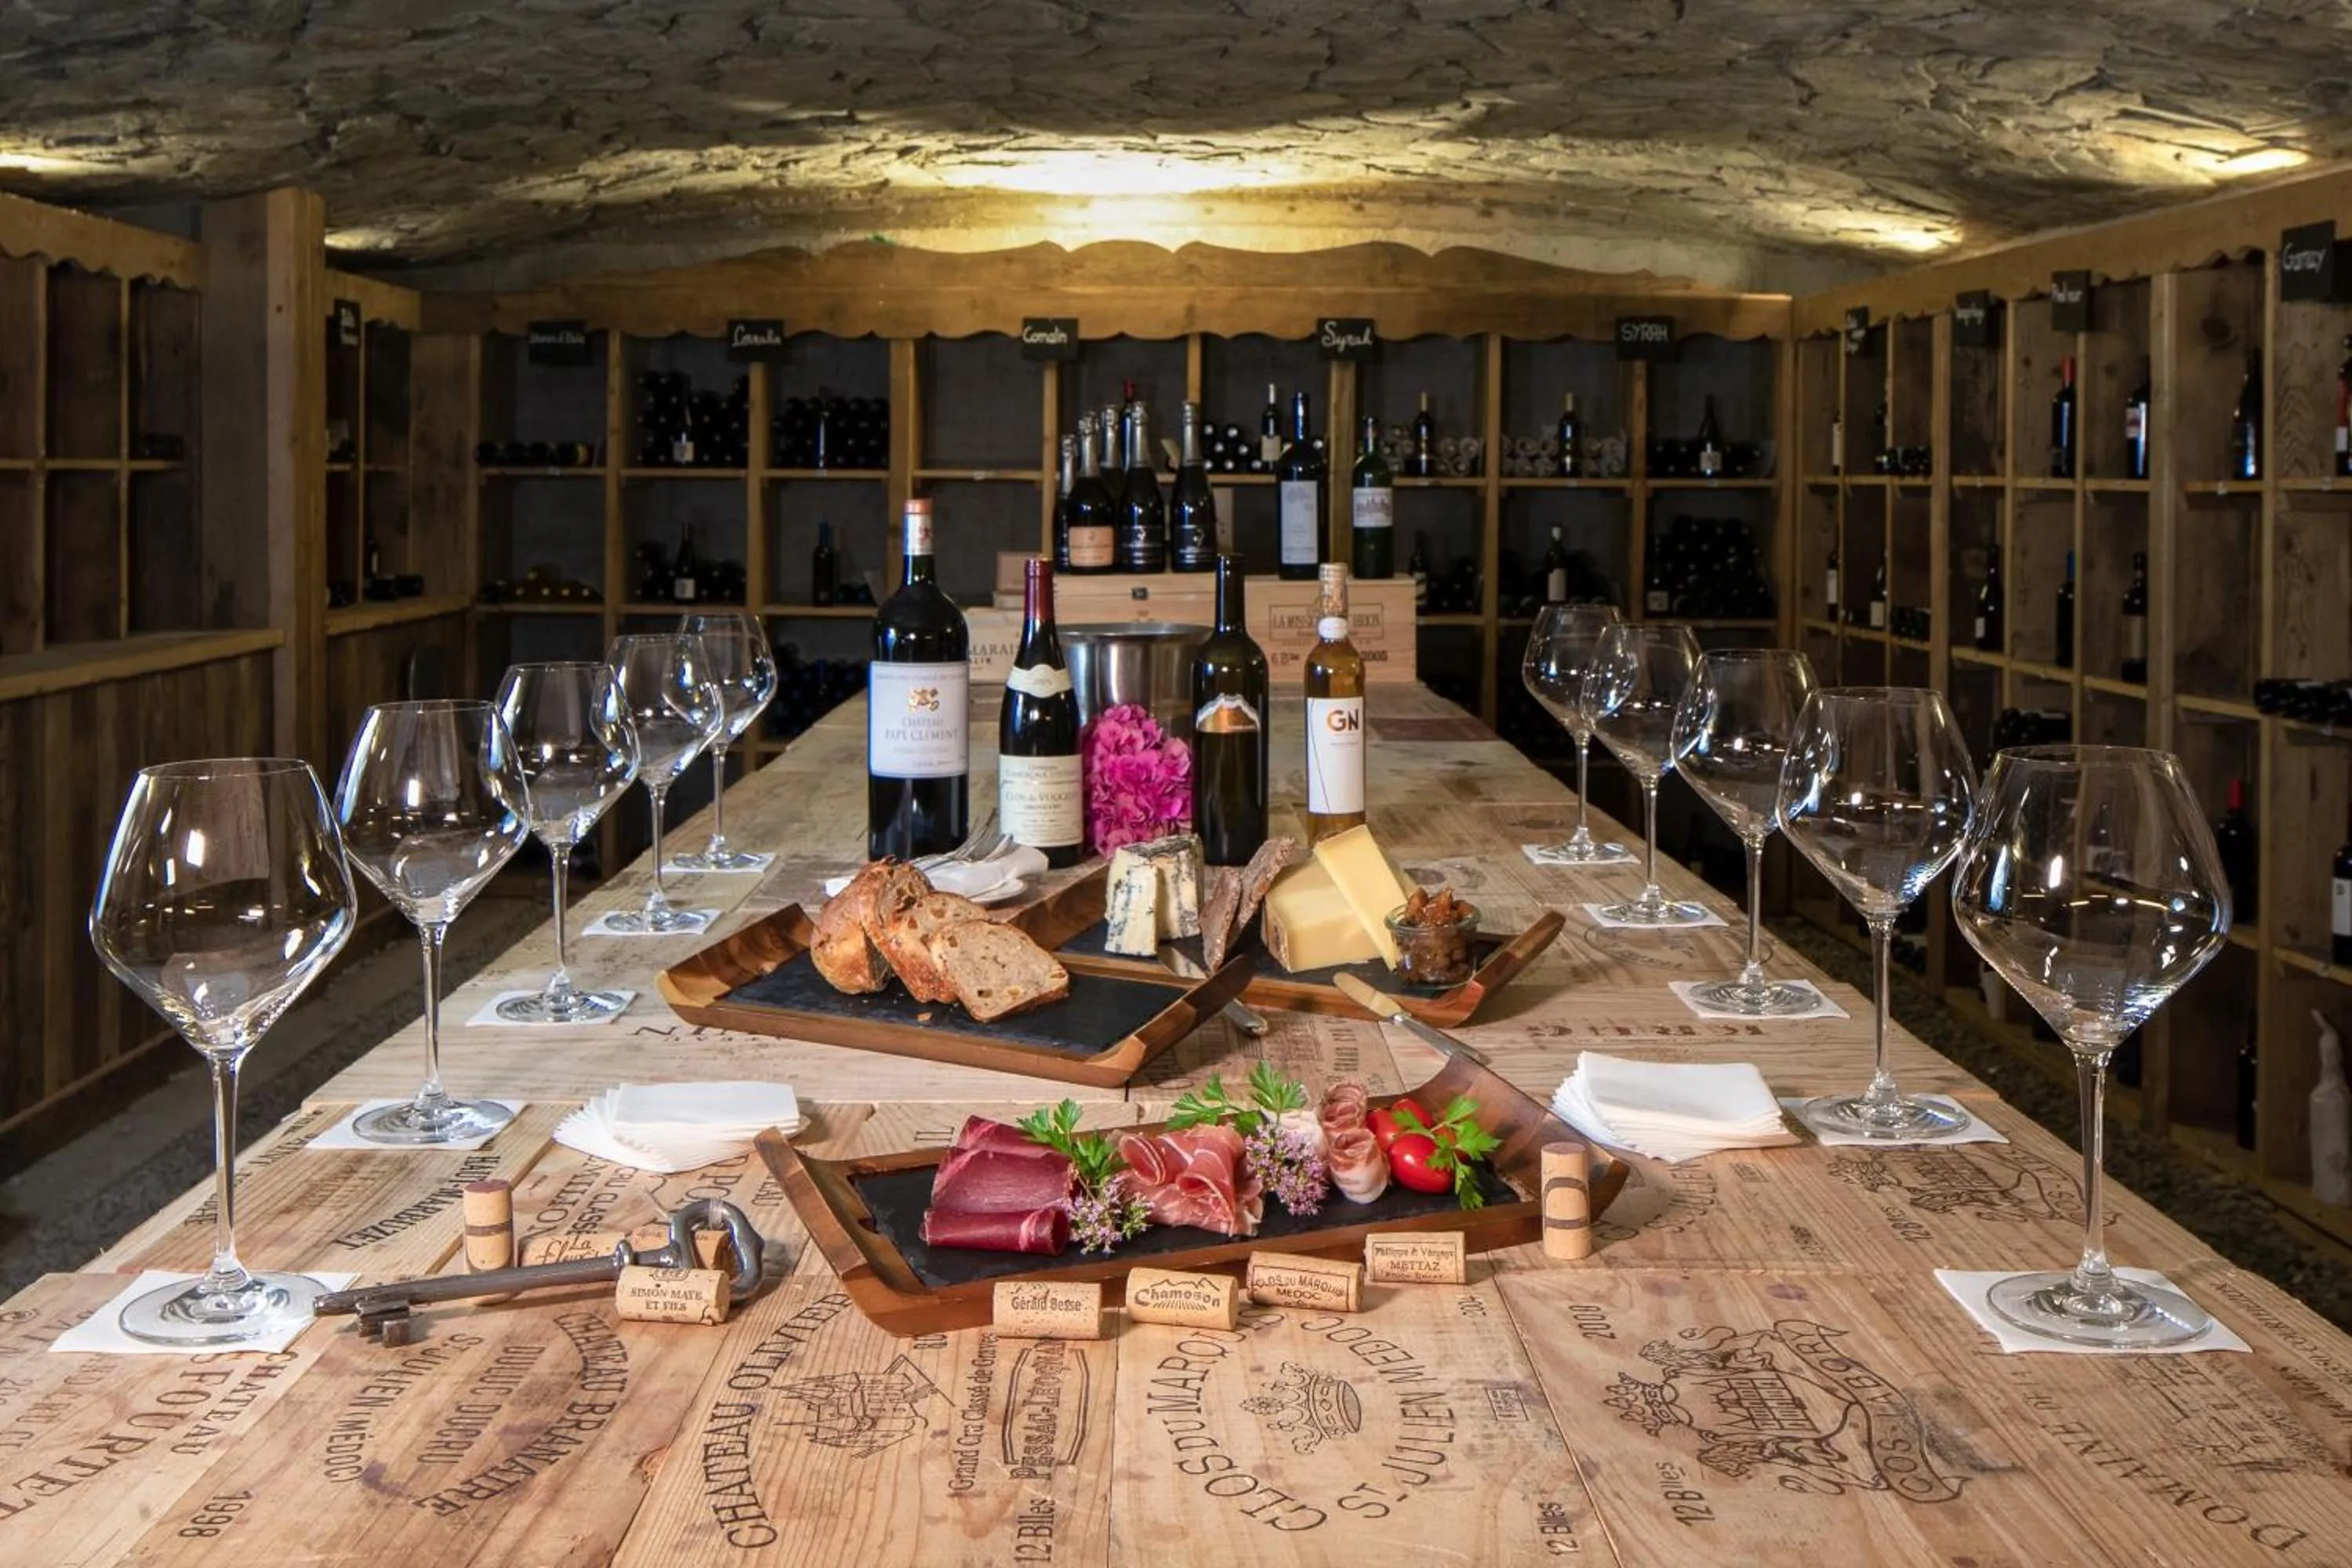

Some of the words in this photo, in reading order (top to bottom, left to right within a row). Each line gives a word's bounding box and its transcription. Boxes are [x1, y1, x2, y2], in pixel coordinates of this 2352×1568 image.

[1320, 321, 1373, 352] Syrah
[1621, 322, 1669, 342] SYRAH
[1327, 709, 1359, 731] GN
[1390, 1260, 1440, 1271] METTAZ
[629, 1287, 669, 1298] SIMON
[645, 1301, 659, 1311] ET
[662, 1301, 688, 1312] FILS
[1050, 1298, 1082, 1312] Besse
[1134, 1287, 1221, 1308] Chamoson
[1569, 1305, 1617, 1340] 2000
[554, 1312, 628, 1393] CHATEAU
[348, 1347, 451, 1408] JULIEN
[470, 1345, 546, 1396] DULUC
[972, 1365, 993, 1384] de
[171, 1351, 299, 1456] CHATEAU
[416, 1403, 502, 1465] DUCRU
[1162, 1418, 1220, 1452] DU
[1381, 1392, 1455, 1486] JULIEN
[411, 1400, 616, 1516] BRANAIRE
[702, 1401, 778, 1548] CHATEAU
[1174, 1453, 1328, 1532] CLOS
[2056, 1421, 2308, 1552] DOMAINE
[179, 1490, 253, 1537] 1998
[1671, 1505, 1716, 1526] 12
[1014, 1539, 1053, 1563] 12
[1545, 1539, 1580, 1556] 12
